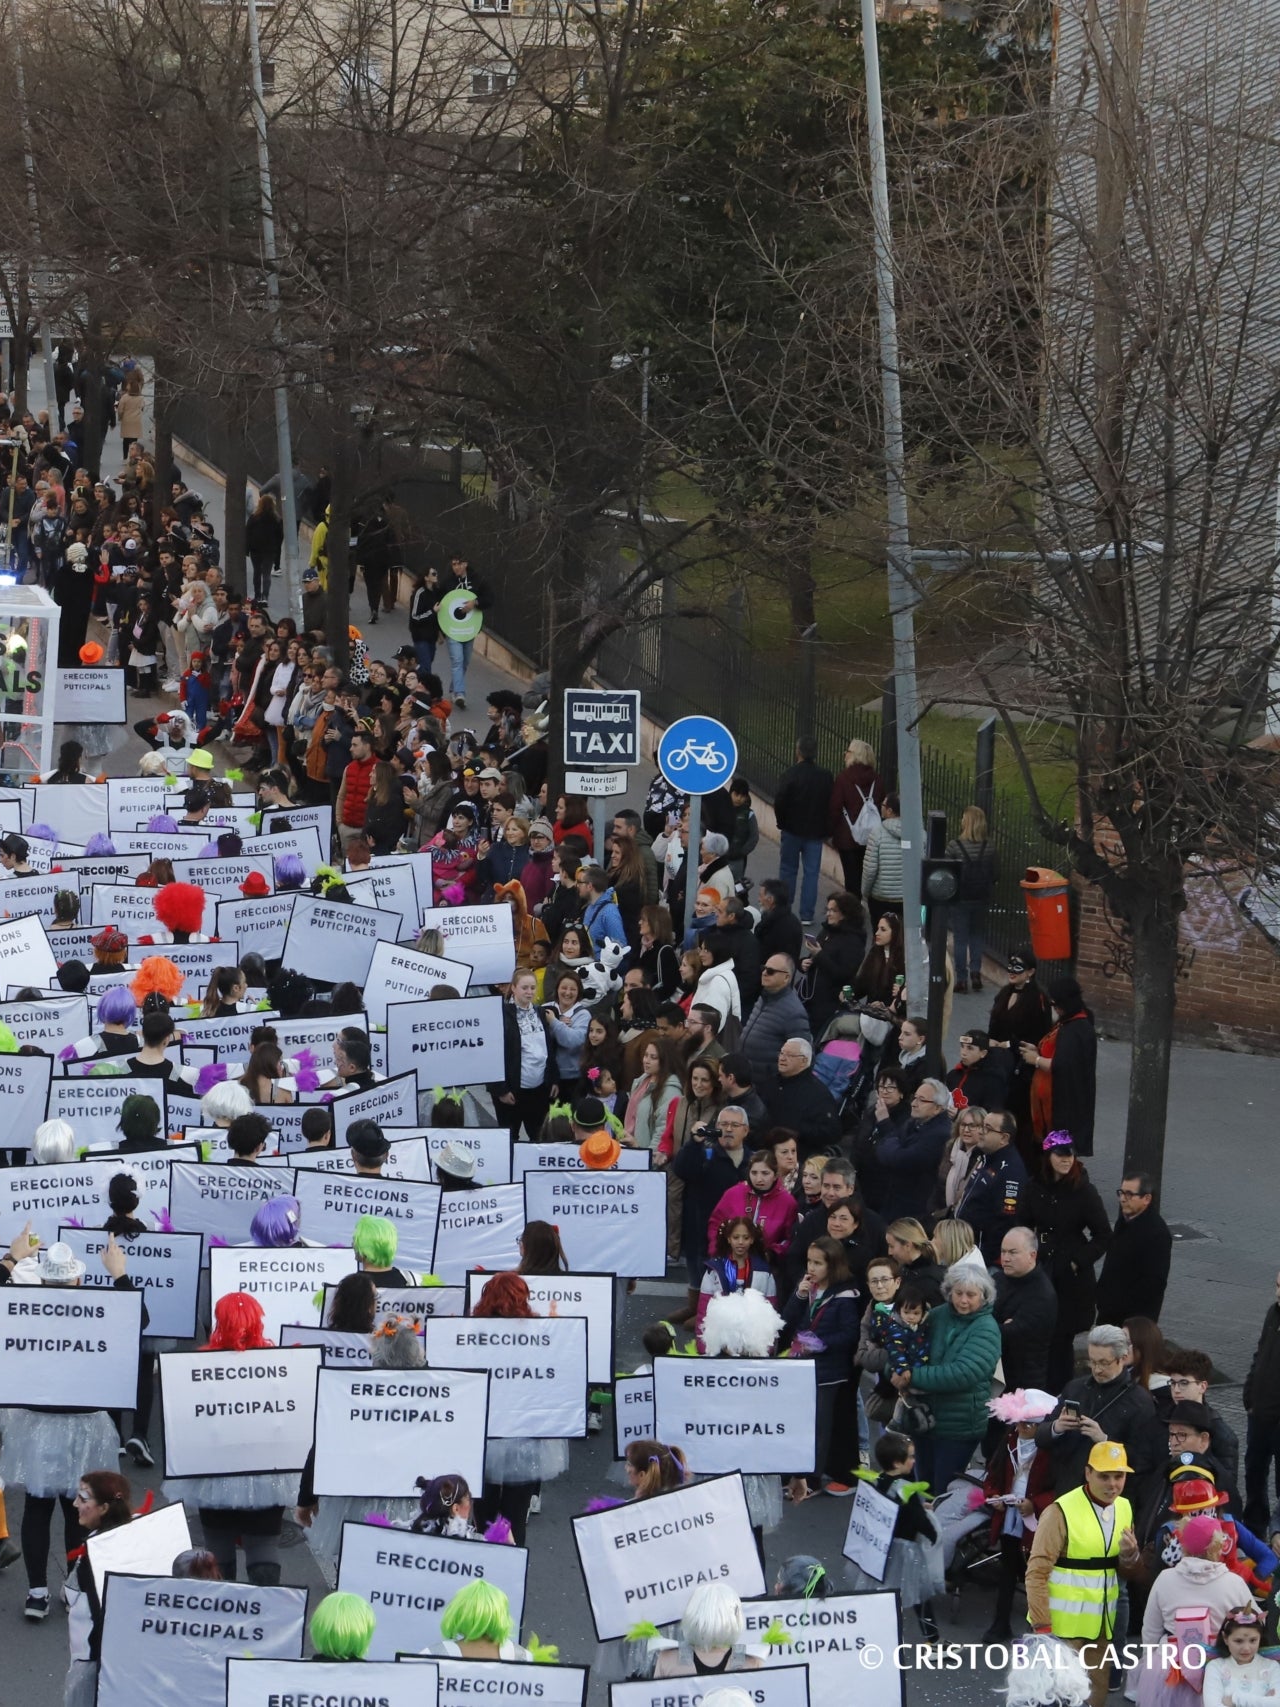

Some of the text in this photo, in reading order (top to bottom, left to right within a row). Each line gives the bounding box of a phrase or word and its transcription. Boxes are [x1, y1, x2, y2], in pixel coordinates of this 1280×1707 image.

[63, 673, 109, 681] ERECCIONS
[570, 732, 633, 754] TAXI
[120, 785, 172, 794] ERECCIONS
[129, 842, 188, 851] ERECCIONS
[241, 840, 298, 855] ERECCIONS
[188, 866, 250, 876] ERECCIONS
[190, 876, 244, 887] PUTICIPAL
[4, 885, 60, 899] ERECCIONS
[111, 910, 155, 920] PUTICIP
[234, 904, 292, 918] ERECCIONS
[313, 907, 376, 927] ERECCIONS
[442, 914, 494, 926] ERECCIONS
[310, 918, 376, 938] PUTICIPALS
[391, 956, 448, 980] ERECCIONS
[384, 980, 430, 998] PUTICIPA
[412, 1018, 480, 1033] ERECCIONS
[284, 1032, 337, 1046] ERECCIO
[412, 1038, 484, 1053] PUTICIPALS
[349, 1091, 400, 1116] ERECCIONS
[58, 1106, 121, 1118] PUTICIPA
[10, 1176, 94, 1192] ERECCIONS
[198, 1176, 282, 1190] ERECCIONS
[552, 1184, 635, 1196] ERECCIONS
[324, 1184, 409, 1202] ERECCIONS
[12, 1194, 100, 1212] PUTICIPALS
[324, 1200, 414, 1218] PUTICIPALS
[440, 1198, 498, 1214] ECCIONS
[552, 1204, 639, 1216] PUTICIPALS
[441, 1213, 504, 1230] TICIPALS
[239, 1261, 326, 1272] ERECCIONS
[528, 1290, 582, 1302] CCIONS
[8, 1302, 105, 1318] ERECCIONS
[5, 1338, 108, 1352] PUTICIPALS
[456, 1333, 551, 1347] ERECCIONS
[191, 1365, 288, 1382] ERECCIONS
[684, 1375, 780, 1388] ERECCIONS
[350, 1383, 452, 1399] ERECCIONS
[350, 1408, 455, 1424] PUTICIPALS
[685, 1422, 786, 1436] PUTICIPALS
[614, 1512, 716, 1550] ERECCIONS
[376, 1551, 485, 1578] ERECCIONS
[624, 1564, 730, 1604] PUTICIPALS
[144, 1592, 262, 1616] ERECCIONS
[370, 1590, 446, 1612] PUTICIP
[141, 1618, 264, 1641] PUTICIPALS
